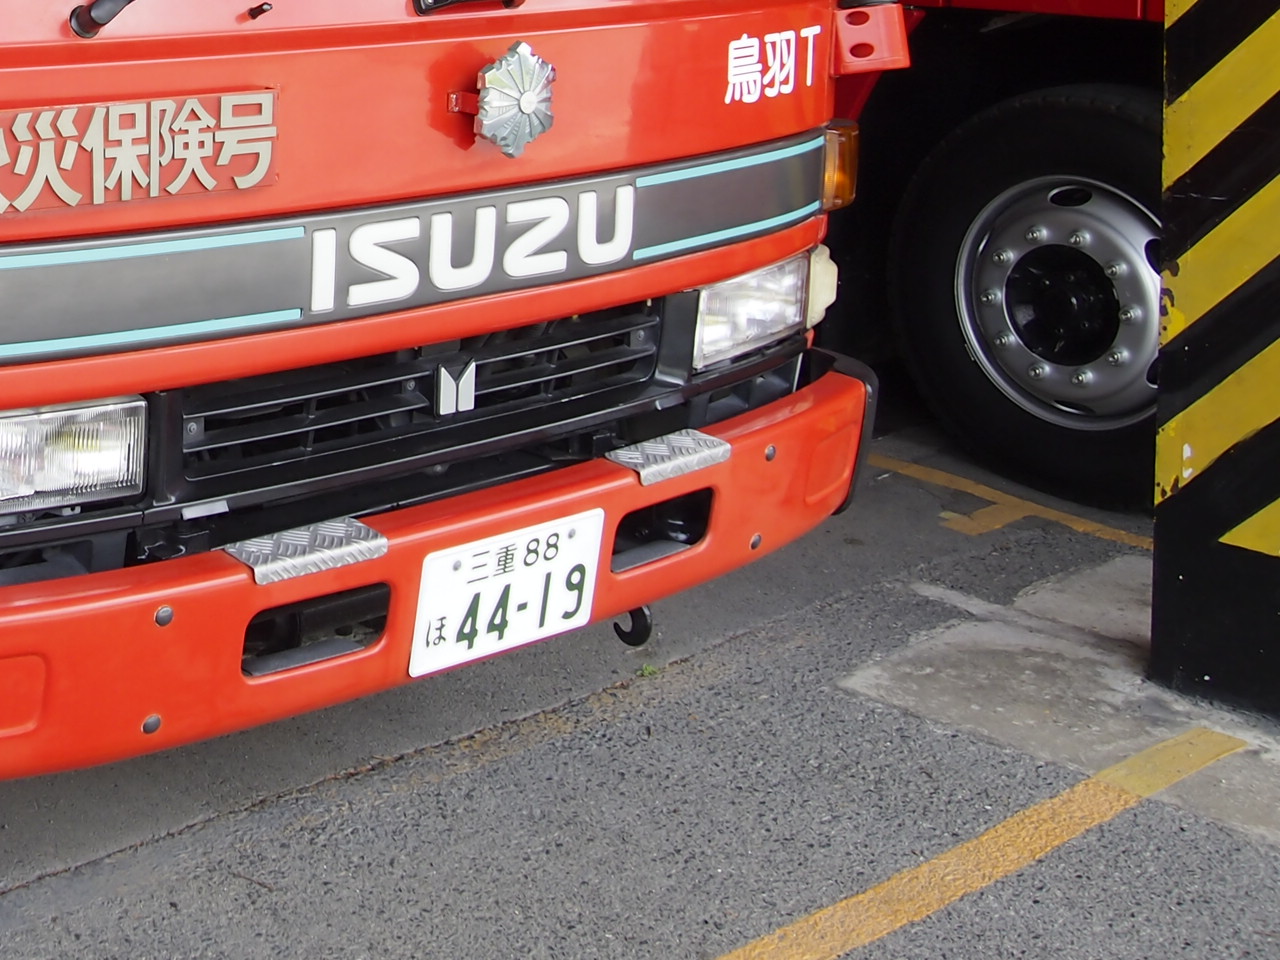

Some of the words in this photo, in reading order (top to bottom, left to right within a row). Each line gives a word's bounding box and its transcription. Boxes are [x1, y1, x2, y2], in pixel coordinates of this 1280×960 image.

[724, 25, 821, 104] 鳥羽T
[311, 184, 634, 313] ISUZU
[426, 616, 448, 648] ほ
[456, 563, 586, 650] 44-19
